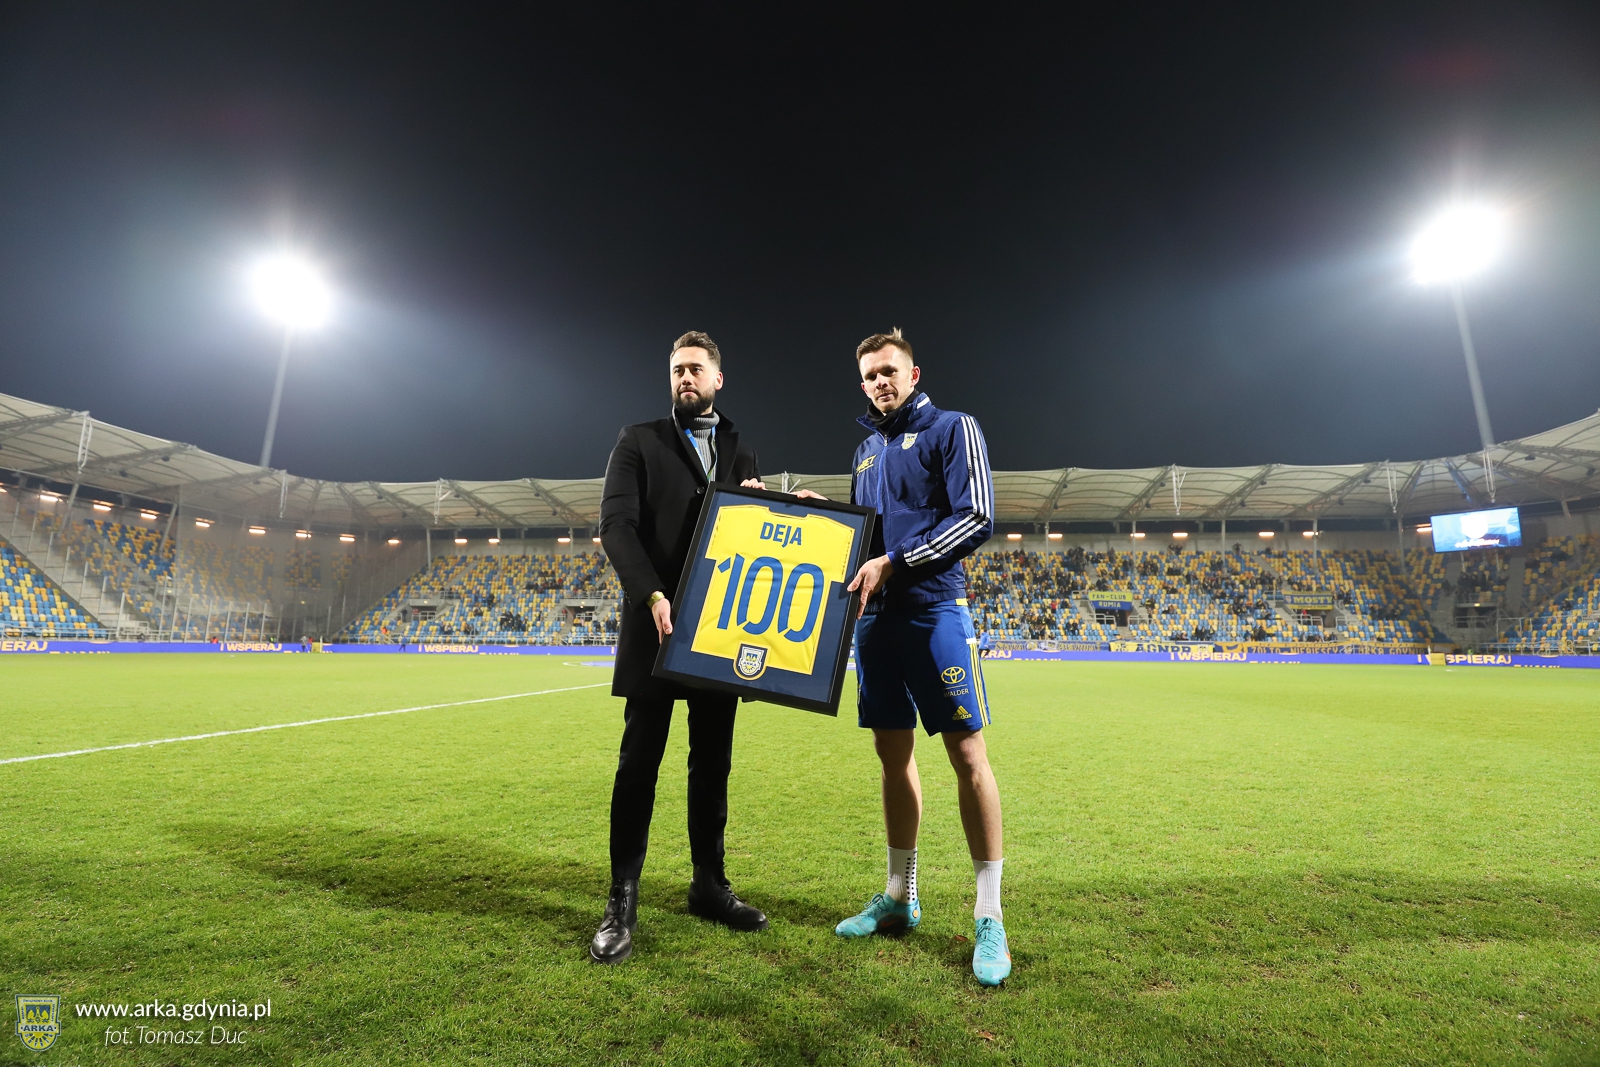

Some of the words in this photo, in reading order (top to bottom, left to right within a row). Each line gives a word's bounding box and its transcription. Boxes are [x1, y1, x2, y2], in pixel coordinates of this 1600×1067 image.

[759, 521, 802, 548] DEJA
[717, 552, 825, 643] 100
[1293, 596, 1333, 604] MOSTY
[0, 641, 48, 652] ERAJ
[226, 643, 282, 651] WSPIERAJ
[424, 644, 479, 653] WSPIERAJ
[1177, 652, 1247, 661] WSPIERAJ
[1425, 654, 1511, 665] SPIERAJ
[943, 688, 970, 698] WALDER
